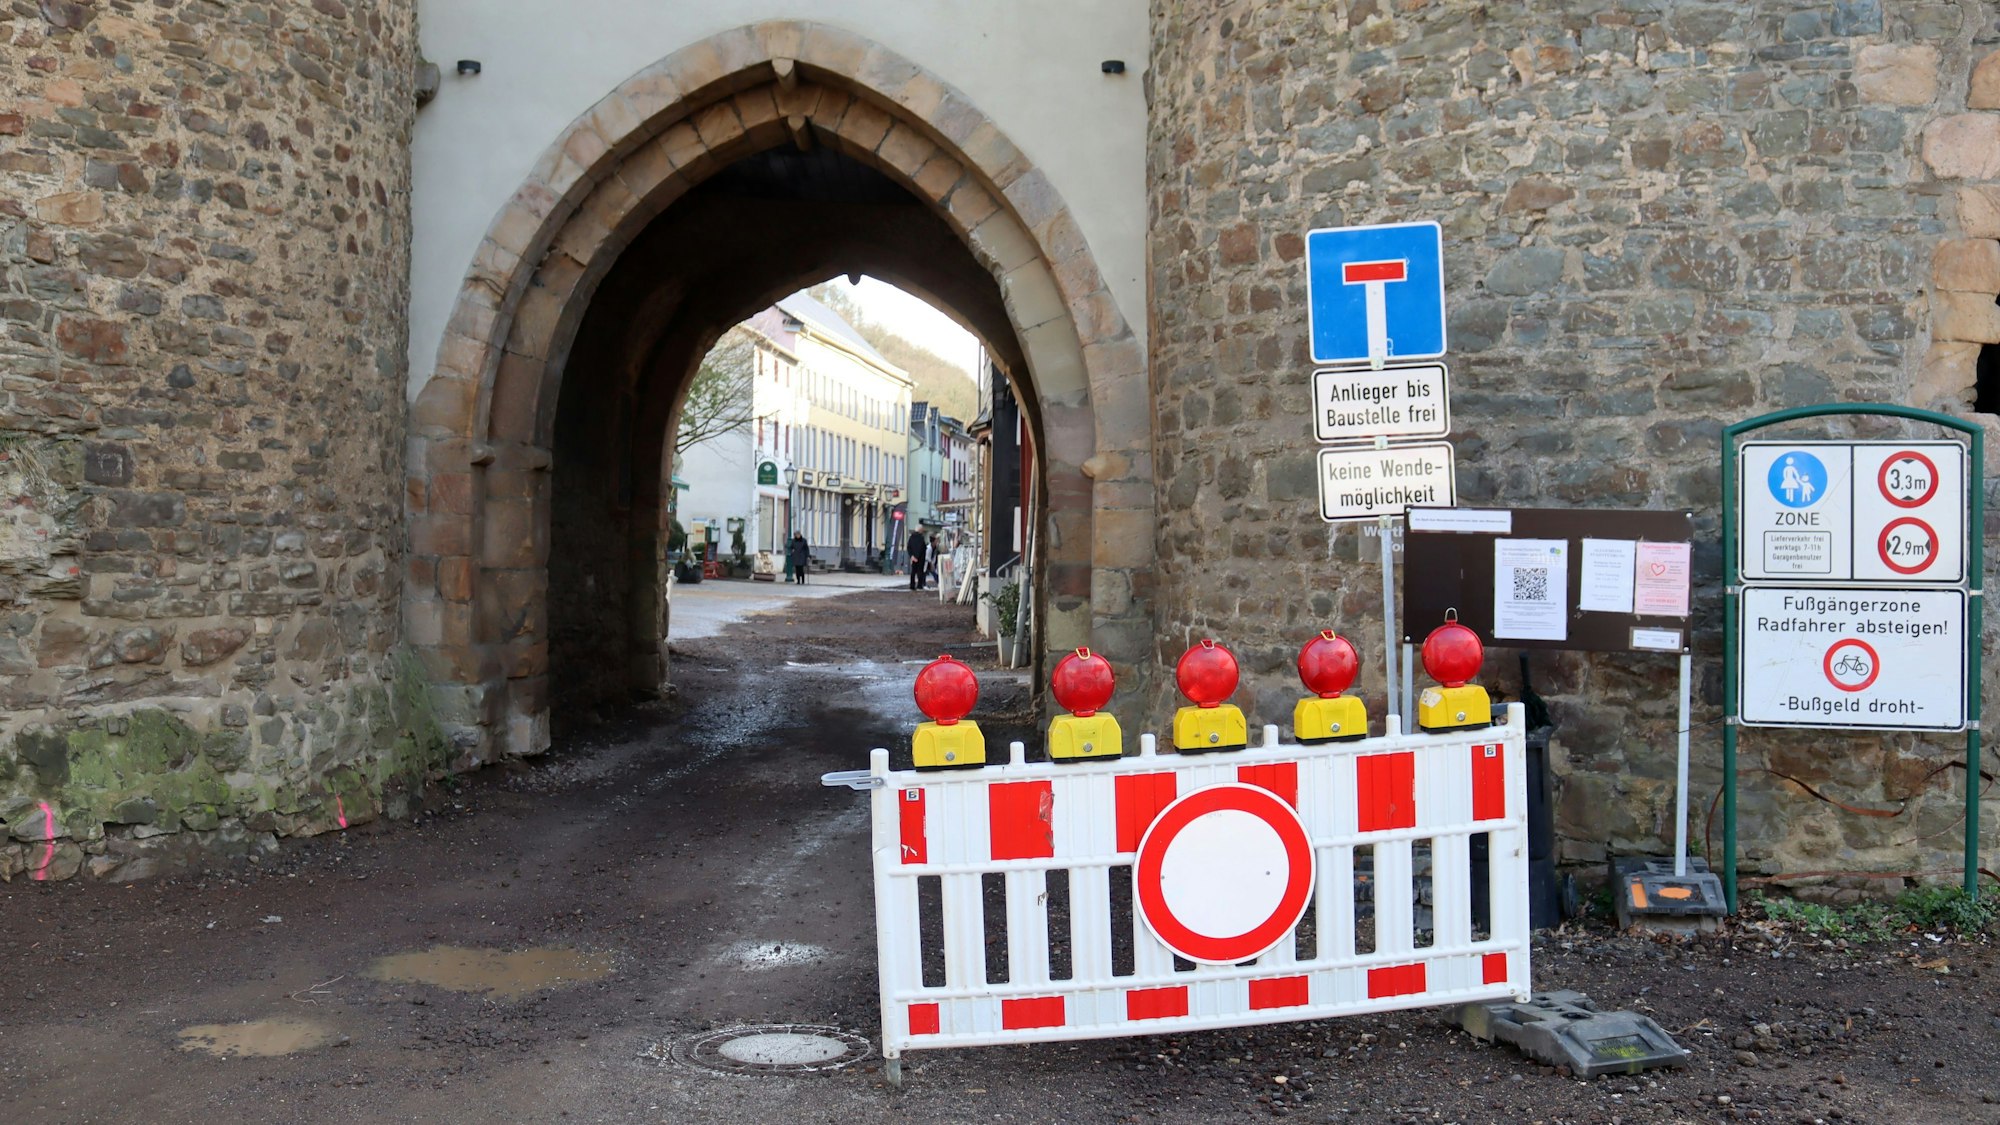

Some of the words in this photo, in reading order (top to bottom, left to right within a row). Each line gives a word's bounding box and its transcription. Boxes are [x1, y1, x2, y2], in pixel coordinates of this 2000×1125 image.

[1330, 383, 1398, 404] Anlieger
[1407, 380, 1430, 398] bis
[1327, 405, 1400, 427] Baustelle
[1408, 404, 1436, 422] frei
[1328, 462, 1372, 481] keine
[1380, 457, 1443, 478] Wende-
[1340, 485, 1435, 510] möglichkeit
[1775, 512, 1820, 526] ZONE
[1771, 535, 1811, 543] Lieferverkehr
[1813, 535, 1824, 543] frei
[1774, 544, 1801, 553] werktags
[1772, 553, 1822, 562] Garagenbenutzer
[1784, 596, 1921, 615] Fußgängerzone
[1758, 617, 1846, 632] Radfahrer
[1856, 619, 1948, 638] absteigen!
[1779, 696, 1860, 715] -Bußgeld
[1869, 698, 1924, 714] droht-
